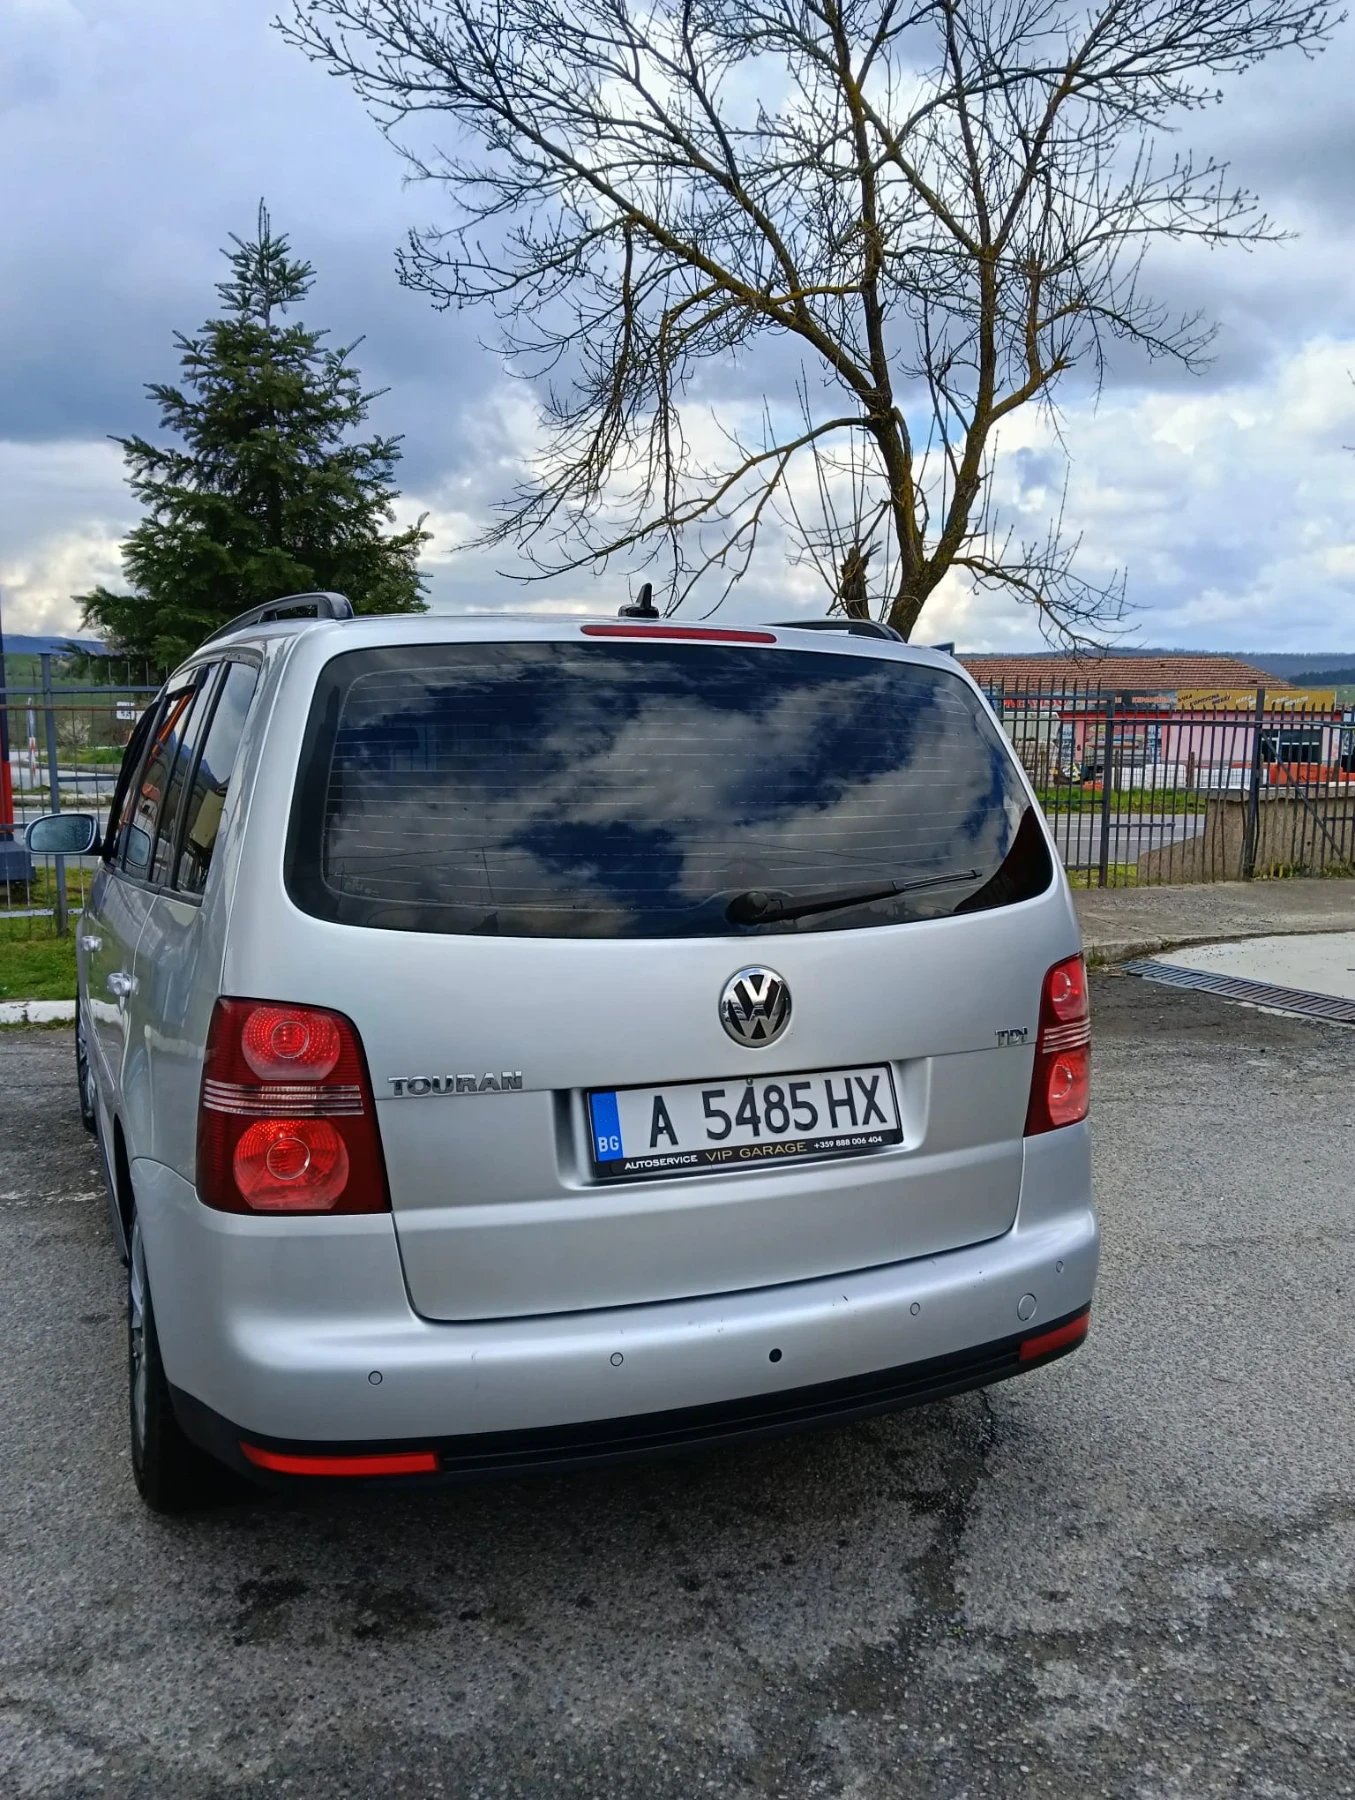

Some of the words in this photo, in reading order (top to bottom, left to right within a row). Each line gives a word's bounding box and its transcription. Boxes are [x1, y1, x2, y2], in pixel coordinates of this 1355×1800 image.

[995, 1027, 1028, 1047] TDI
[388, 1071, 523, 1097] TOURAN
[649, 1095, 679, 1148] A
[701, 1081, 819, 1141] 5485
[824, 1075, 888, 1129] HX
[597, 1134, 621, 1153] BG
[624, 1153, 698, 1171] AUTOSERVICE
[705, 1150, 733, 1163] VIP
[740, 1142, 808, 1158] GARAGE
[813, 1140, 834, 1149] +359
[836, 1138, 850, 1147] 888
[851, 1137, 867, 1146] 006
[868, 1136, 883, 1144] 404
